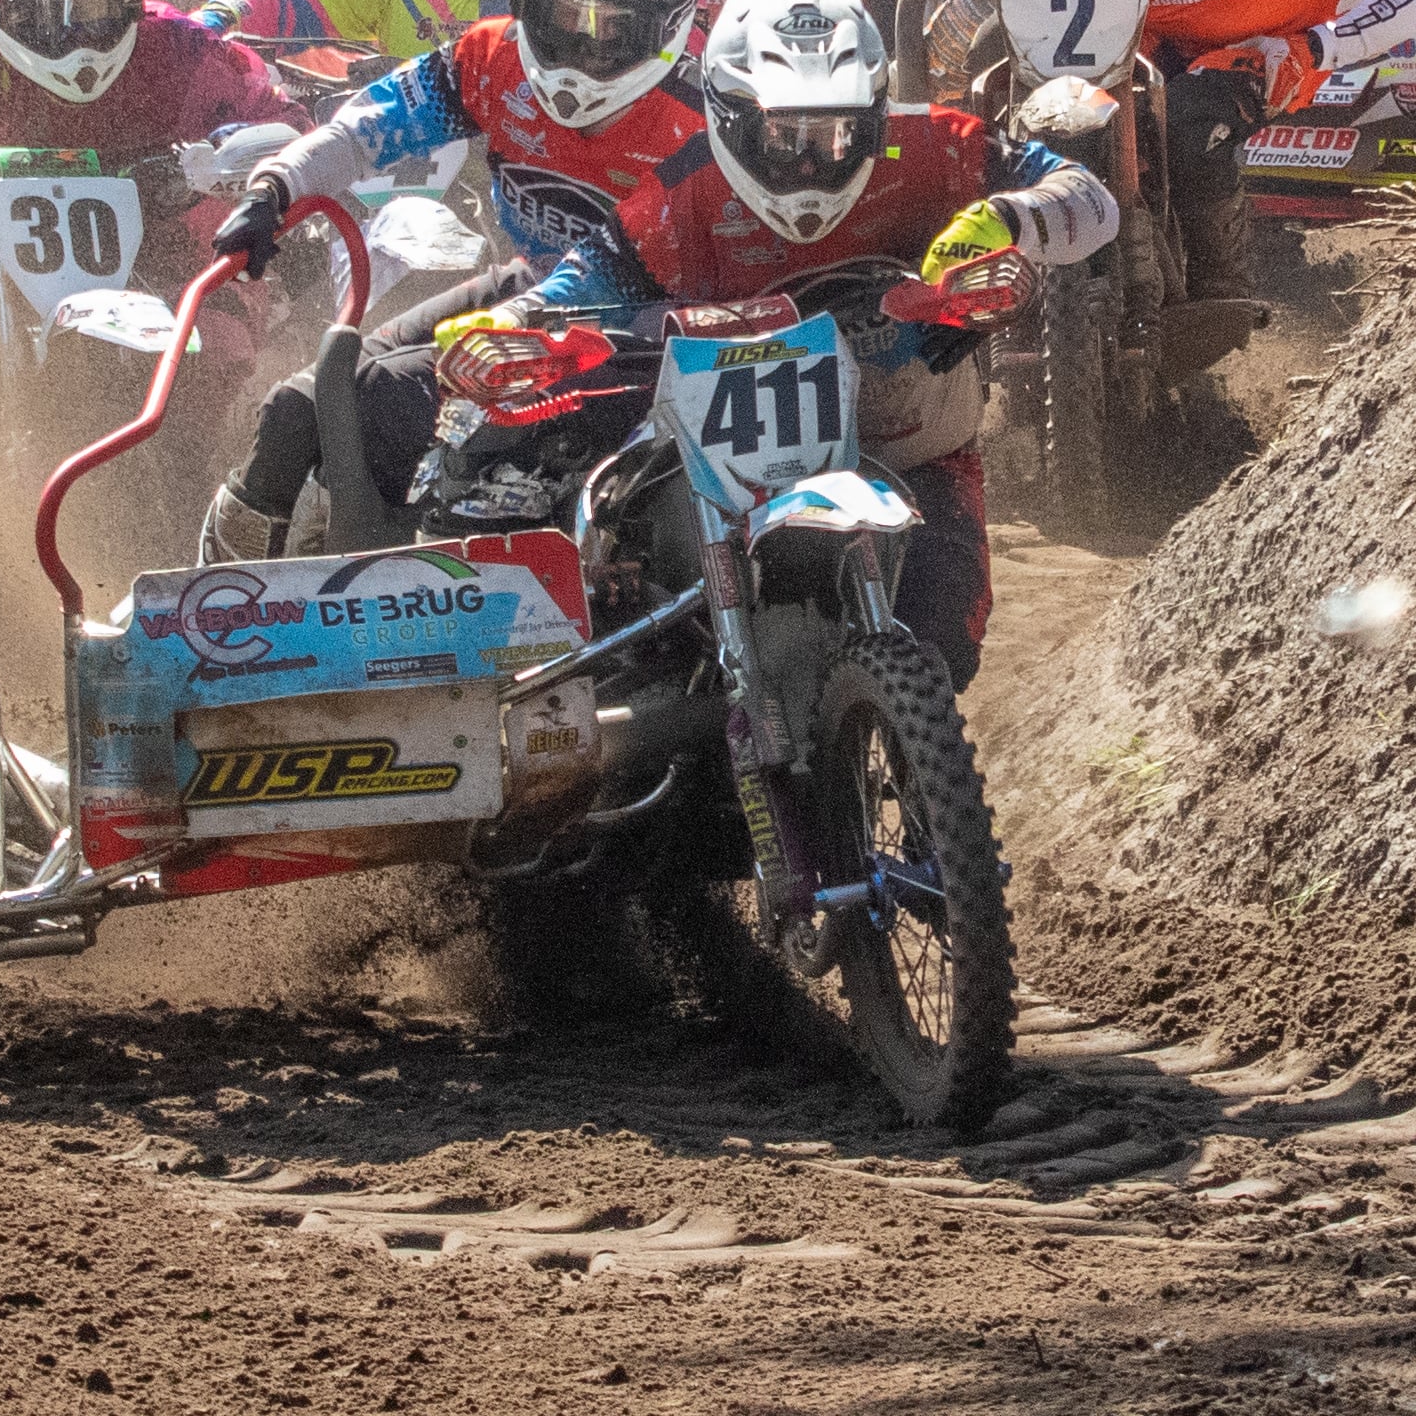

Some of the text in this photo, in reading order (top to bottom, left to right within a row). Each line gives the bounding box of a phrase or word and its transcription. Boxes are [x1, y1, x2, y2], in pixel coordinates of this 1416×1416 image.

[781, 13, 835, 34] Arai
[1247, 148, 1351, 169] framebouw
[10, 195, 122, 276] 30
[717, 342, 786, 367] WSP
[701, 355, 842, 457] 411
[318, 584, 484, 628] DE BRUG
[351, 619, 459, 646] GROEP
[366, 658, 421, 675] Seegers
[107, 721, 163, 737] Peters
[187, 744, 457, 804] WSP RACING.COM
